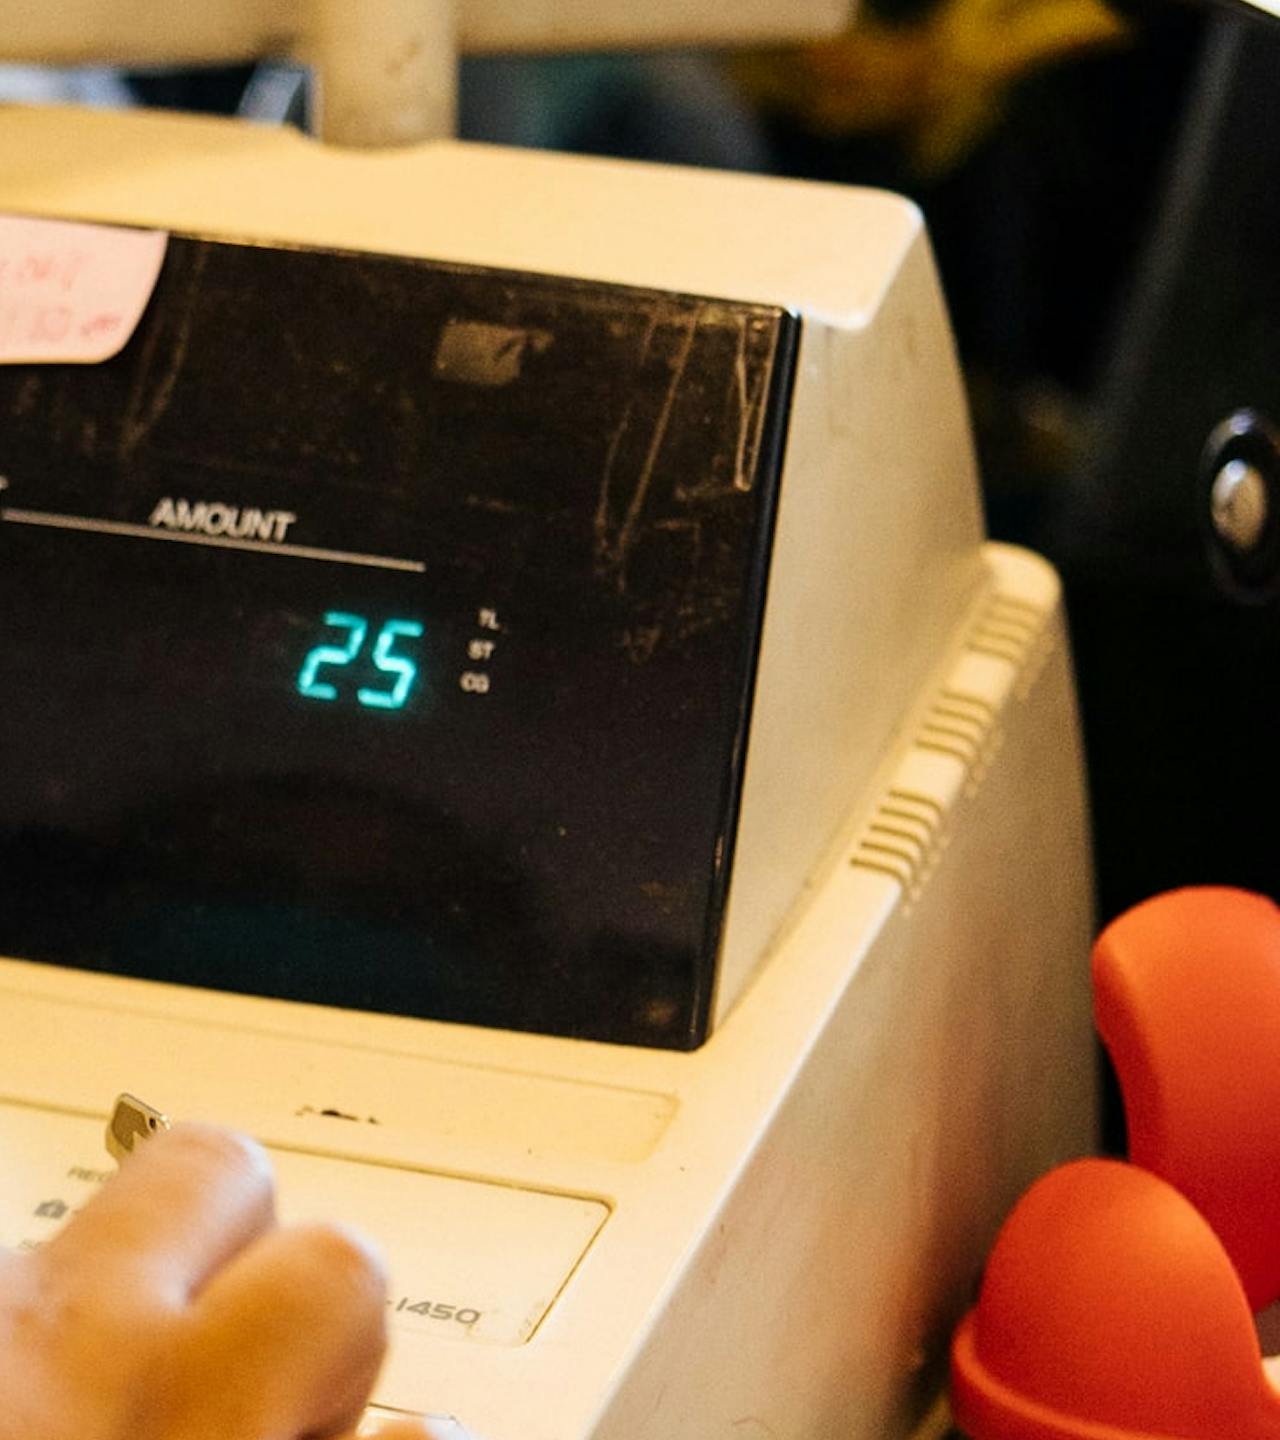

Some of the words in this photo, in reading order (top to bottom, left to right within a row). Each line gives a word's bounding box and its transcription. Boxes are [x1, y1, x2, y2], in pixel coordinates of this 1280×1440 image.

[149, 497, 297, 542] AMOUNT
[298, 611, 424, 709] 25
[468, 640, 495, 660] ST
